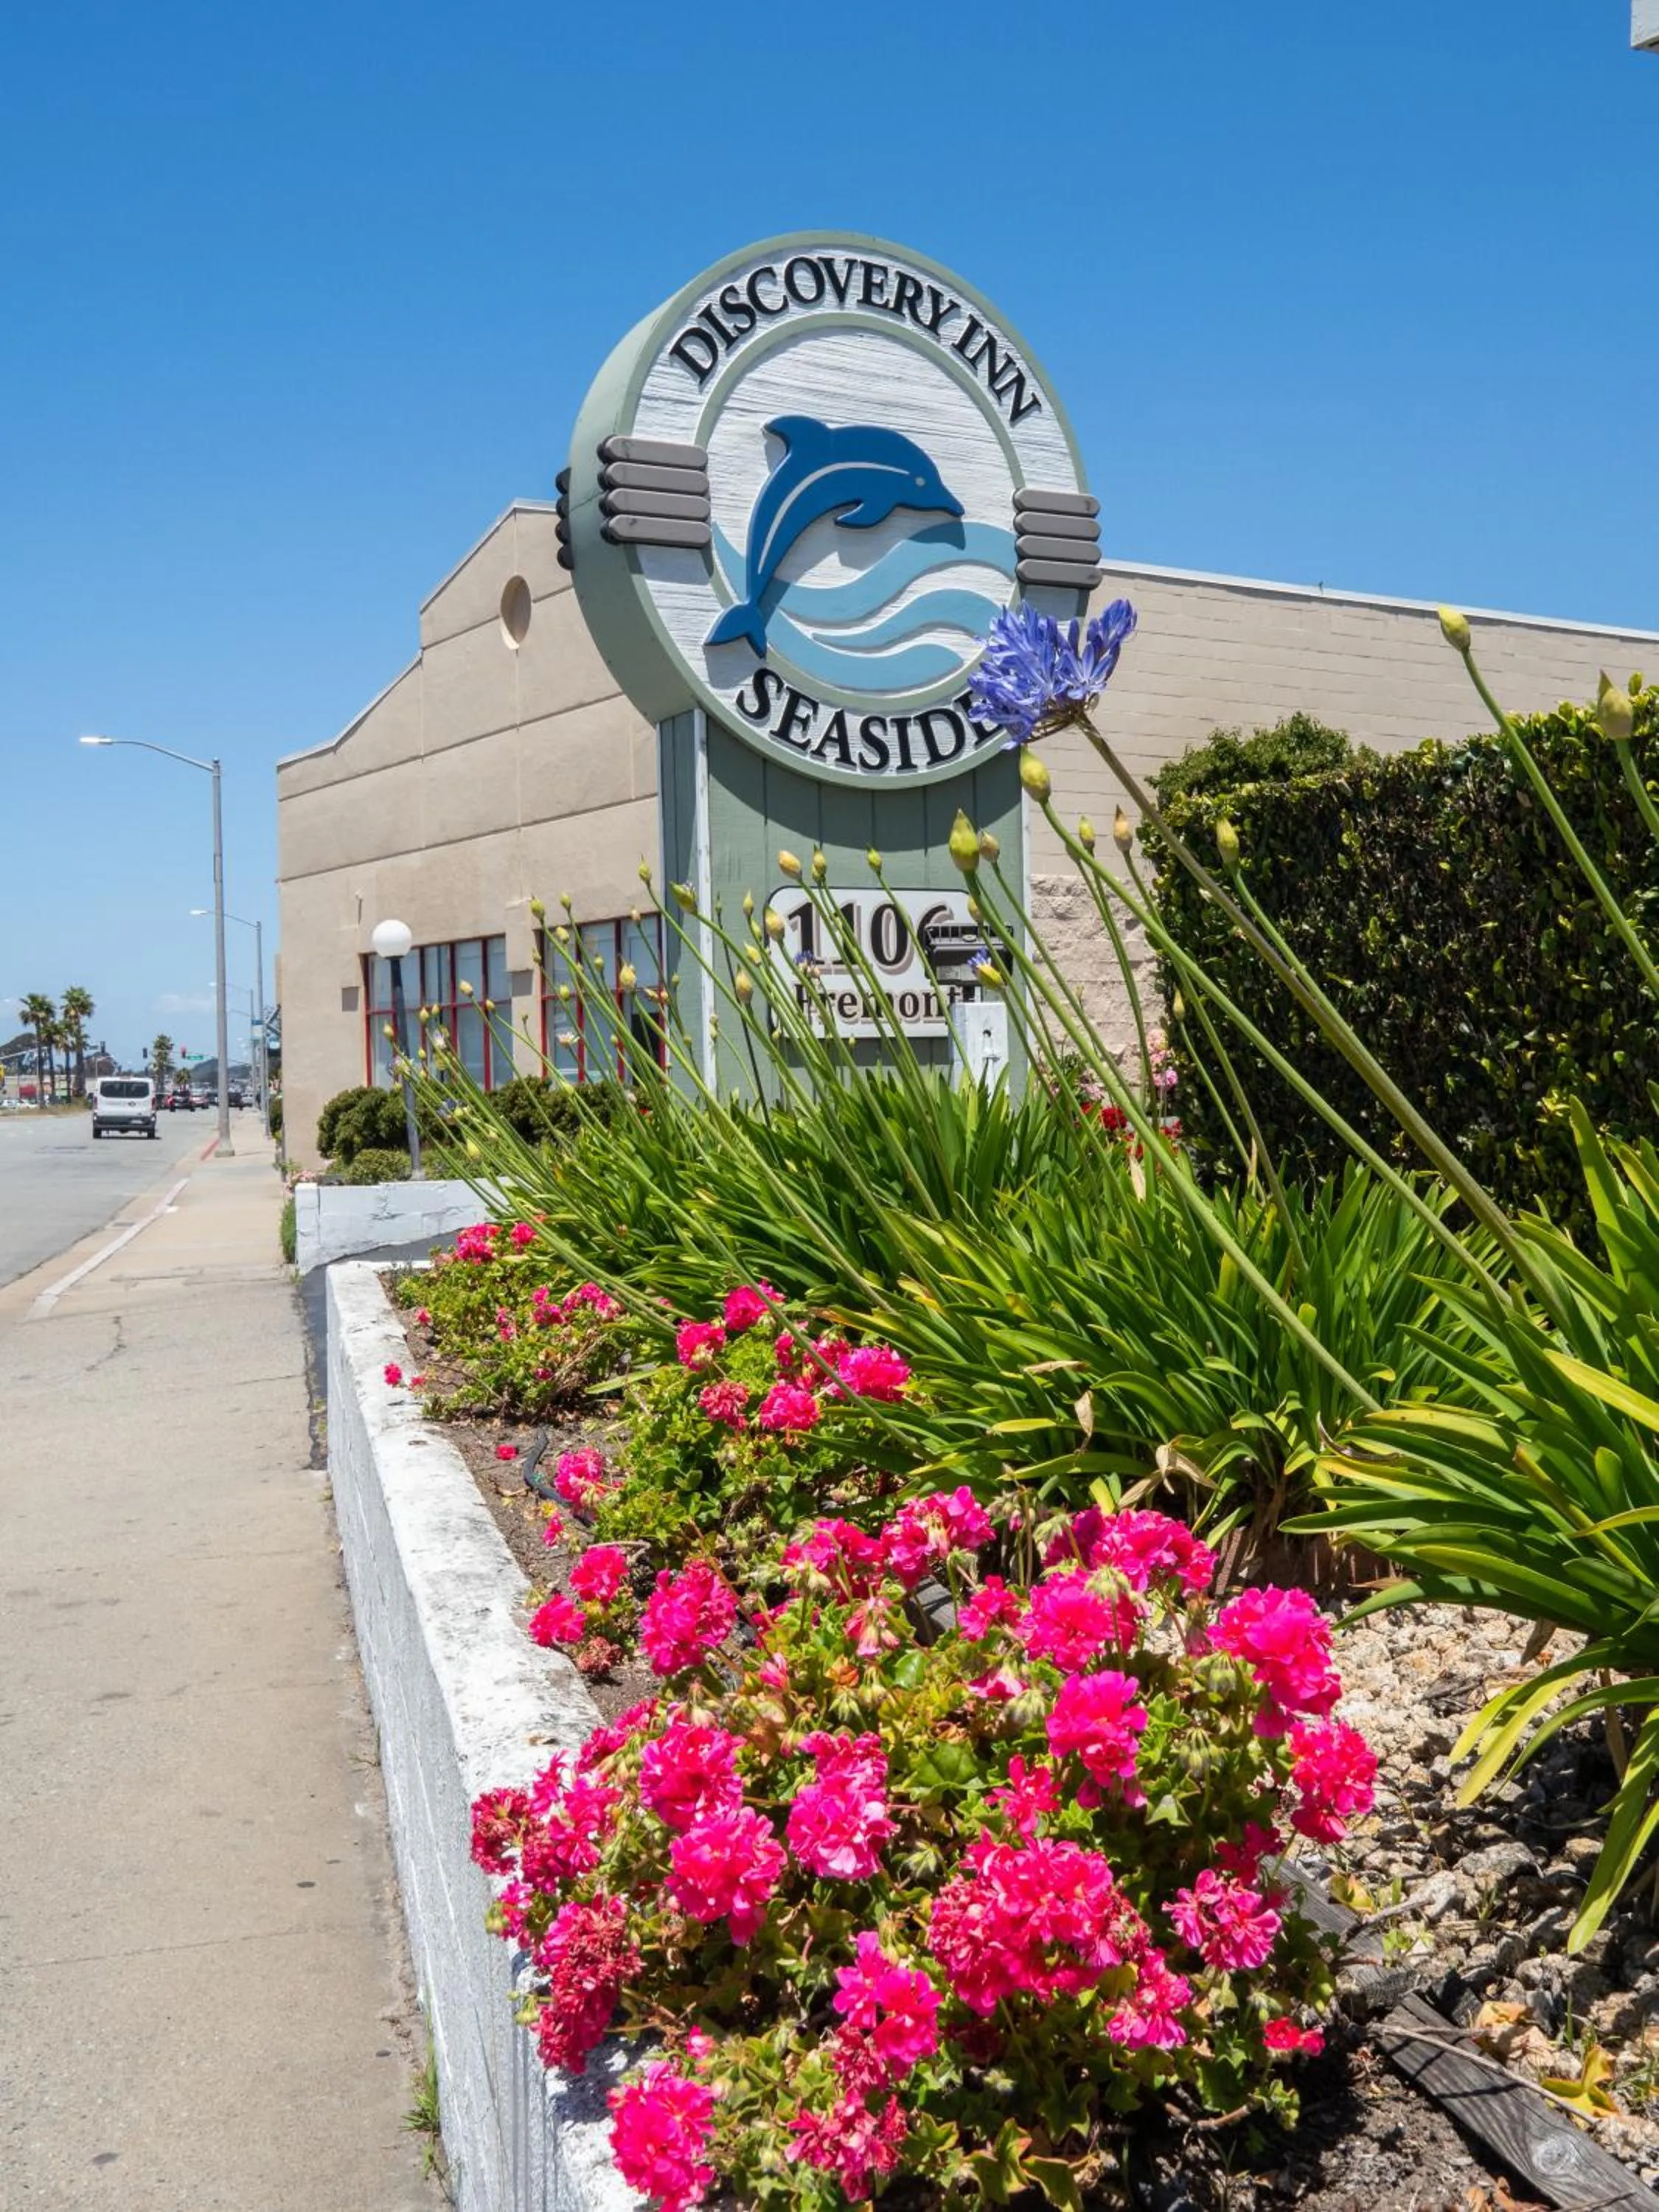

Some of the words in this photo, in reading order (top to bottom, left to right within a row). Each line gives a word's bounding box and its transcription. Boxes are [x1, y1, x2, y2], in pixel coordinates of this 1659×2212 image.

[669, 256, 961, 385] DISCOVERY
[951, 314, 1042, 422] INN
[736, 667, 1004, 771] SEASIDE
